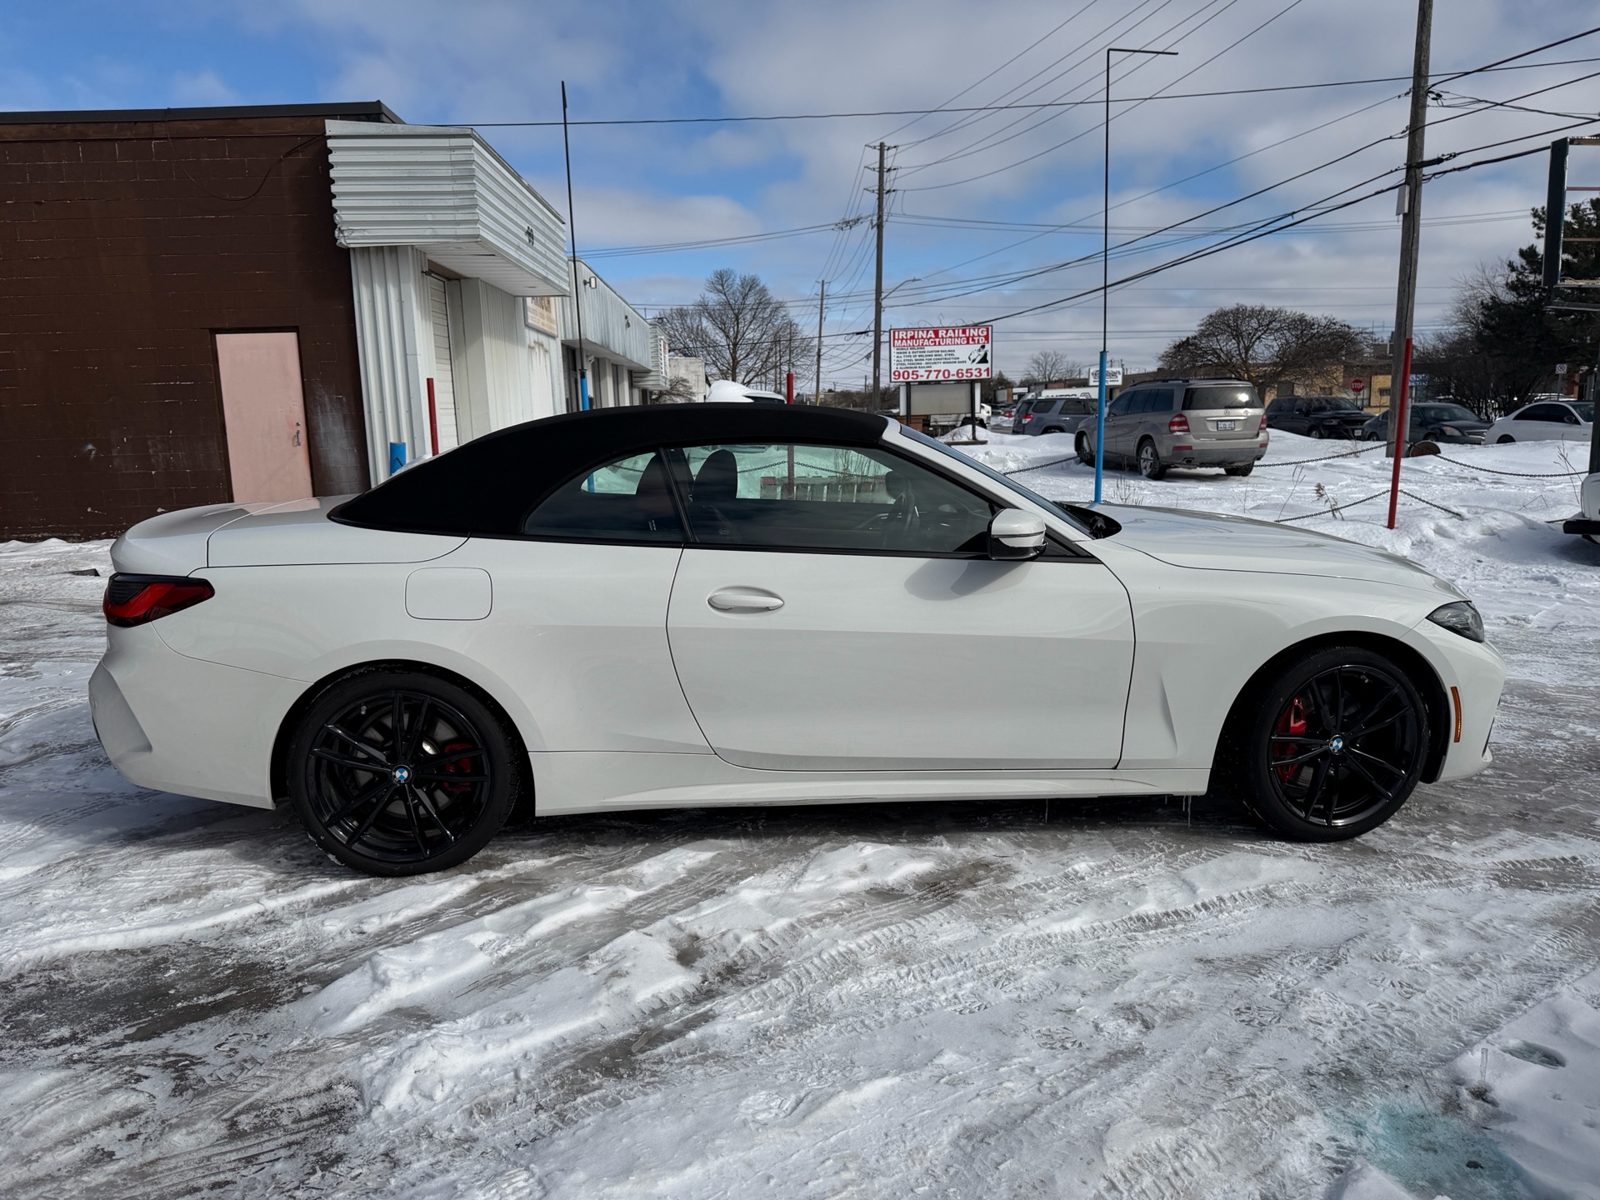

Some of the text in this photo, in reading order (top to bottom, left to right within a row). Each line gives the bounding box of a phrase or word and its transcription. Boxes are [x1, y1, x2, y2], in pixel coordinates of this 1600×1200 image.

[894, 328, 988, 339] IRPINA RAILING
[894, 336, 988, 347] MANUFACTURING LTD.
[892, 367, 990, 380] 905-770-6531
